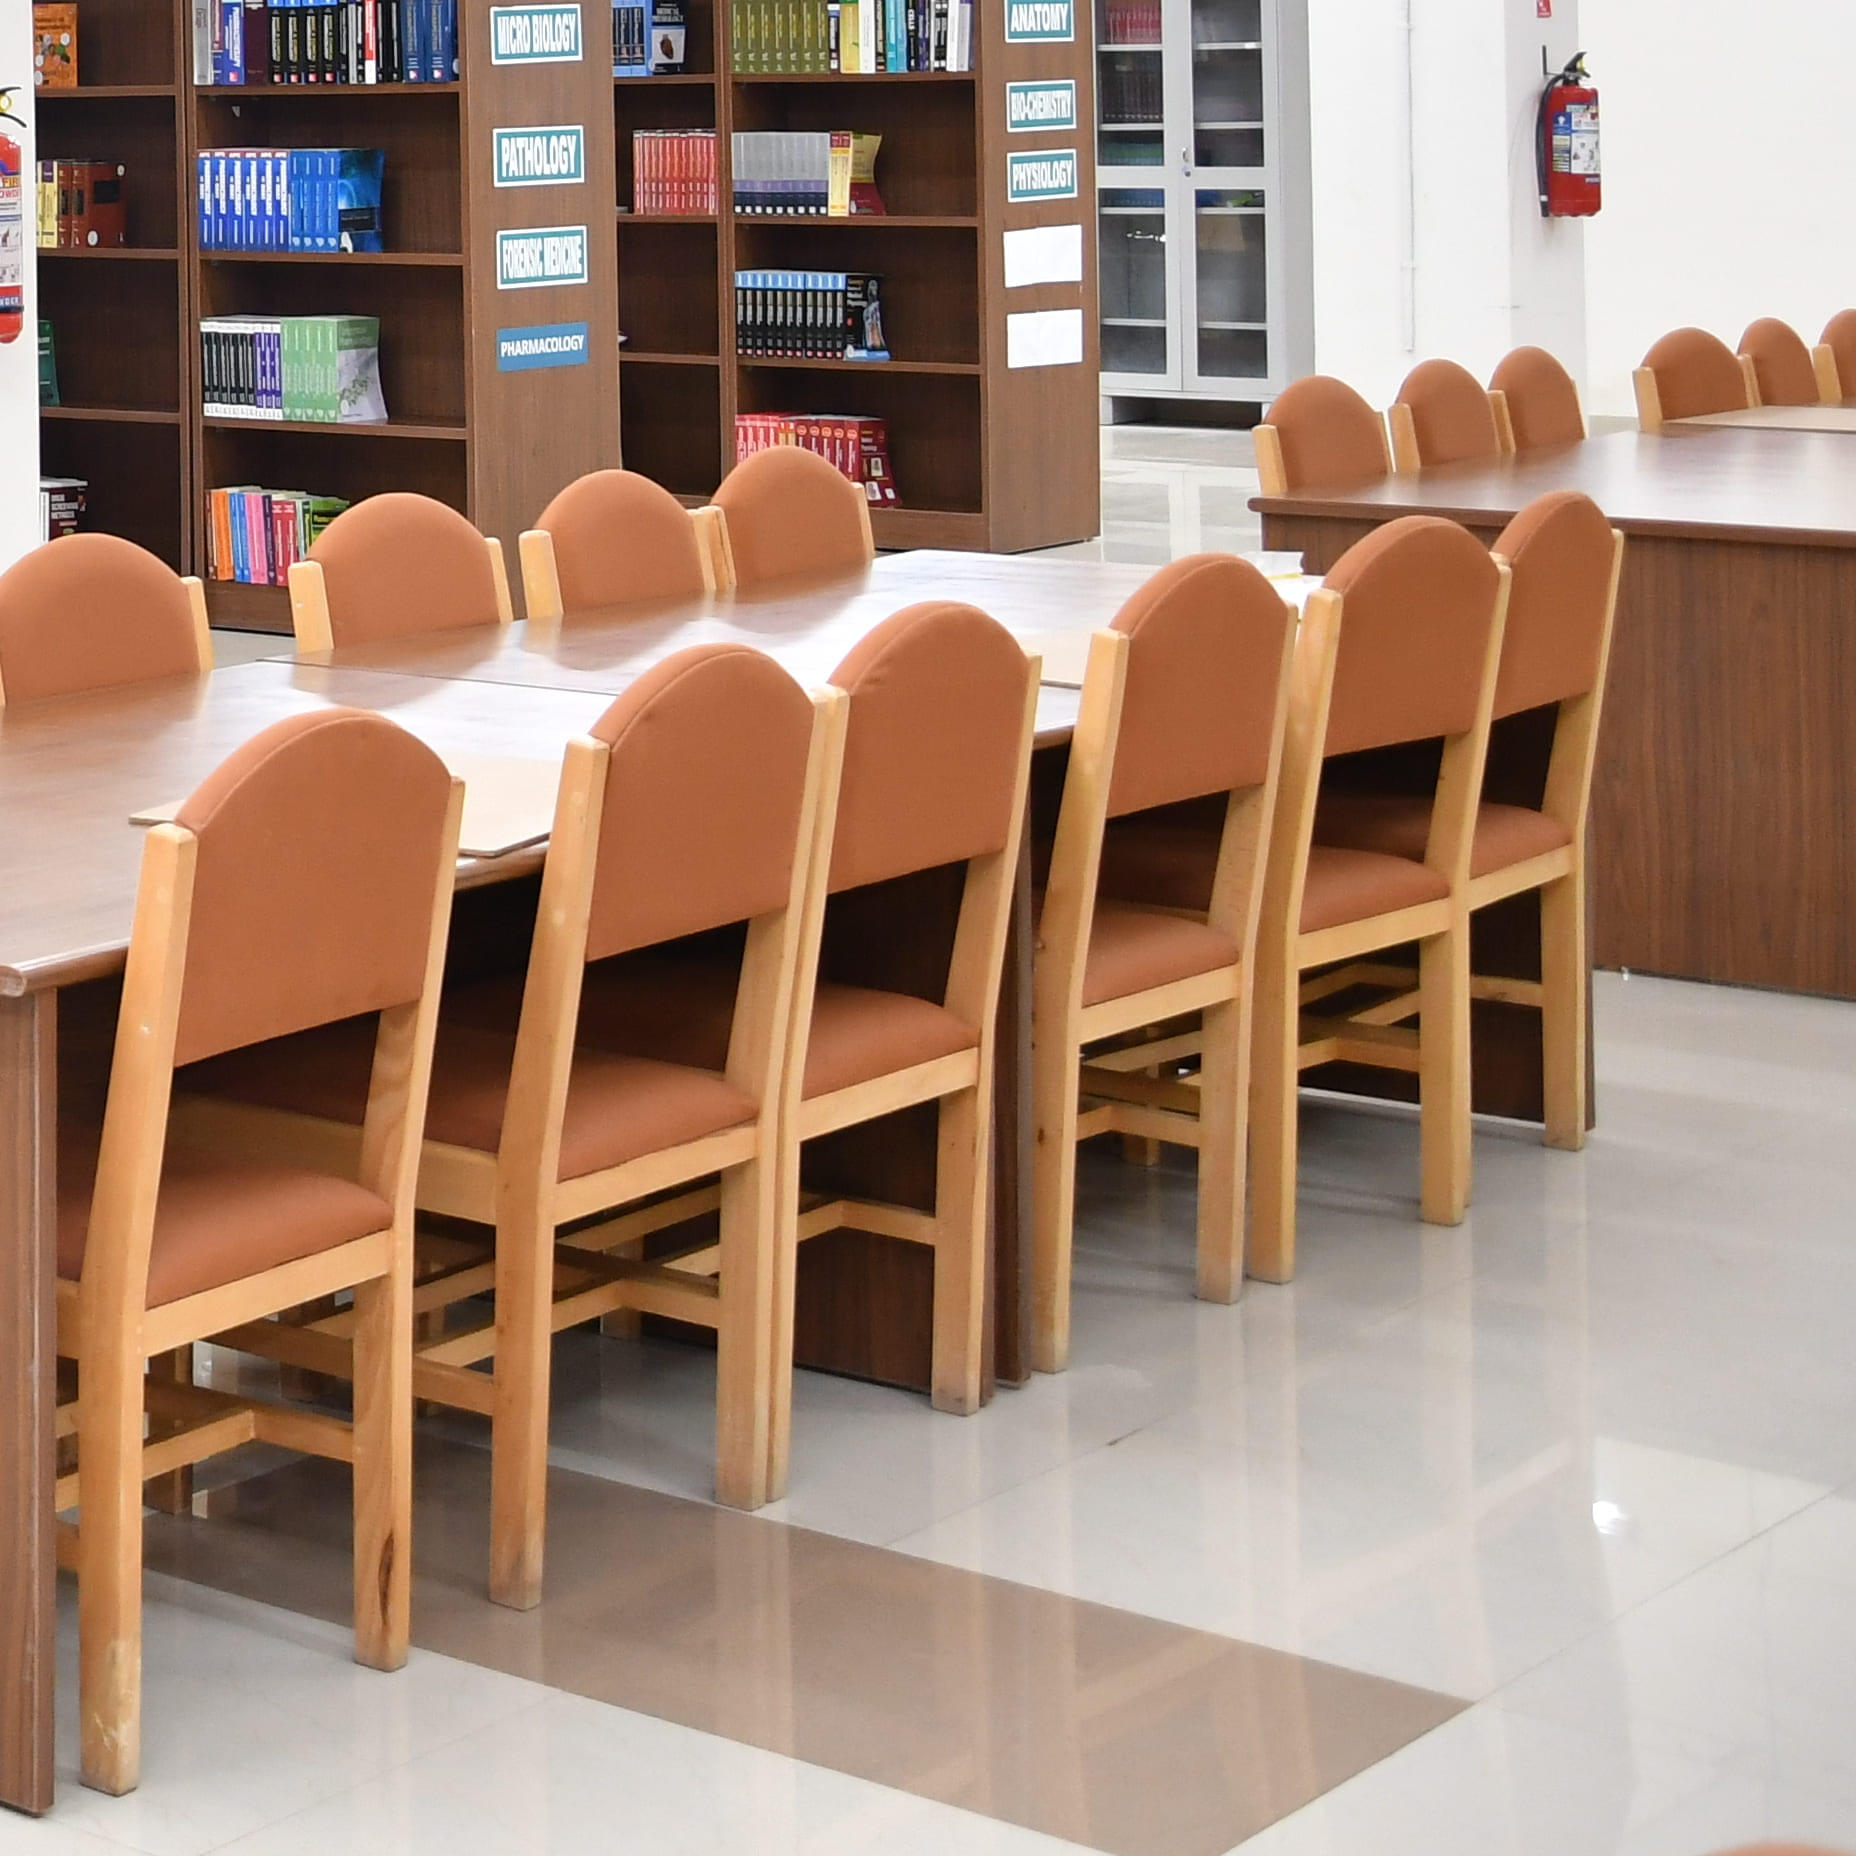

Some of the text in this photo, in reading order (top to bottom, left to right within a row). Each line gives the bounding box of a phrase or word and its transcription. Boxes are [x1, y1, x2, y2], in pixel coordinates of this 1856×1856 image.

[1010, 3, 1068, 32] ANATOMY
[497, 13, 576, 54] MICRO BIOLOGY
[501, 135, 577, 177] PATHOLOGY
[1013, 160, 1072, 191] PHYSIOLOGY
[501, 335, 585, 358] PHARMACOLOGY
